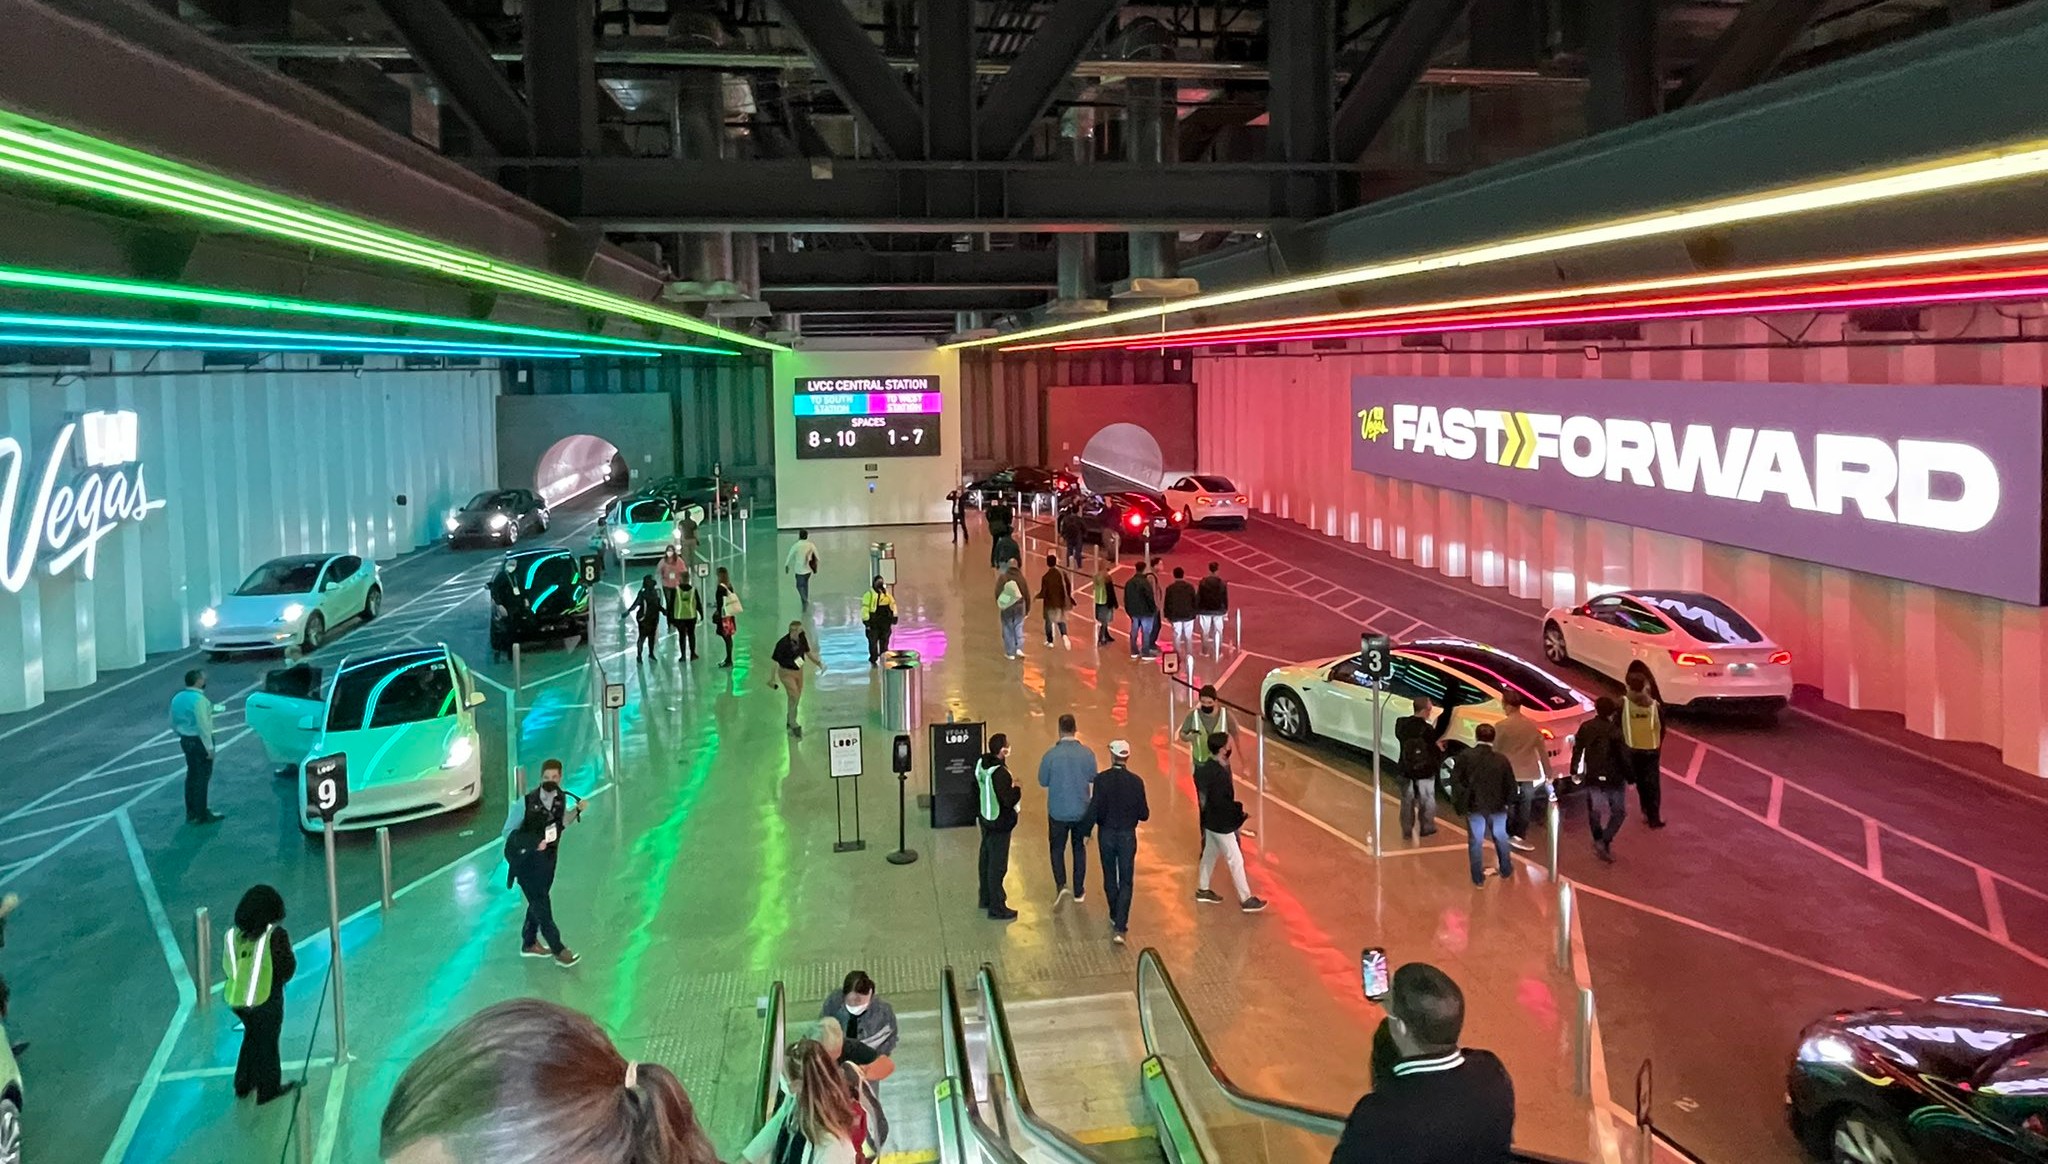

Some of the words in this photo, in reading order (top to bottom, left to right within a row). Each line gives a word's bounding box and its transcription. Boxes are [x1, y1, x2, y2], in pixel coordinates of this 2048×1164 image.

[808, 380, 834, 391] LVCC
[835, 380, 884, 391] CENTRAL
[885, 379, 928, 390] STATION
[823, 394, 854, 404] SOUTH
[898, 394, 922, 404] WEST
[814, 404, 850, 414] STATION
[886, 404, 923, 413] STATION
[851, 418, 886, 427] SPACES
[808, 431, 820, 447] 8
[836, 430, 856, 446] 10
[888, 429, 896, 445] 1
[913, 428, 923, 445] 7
[1393, 404, 1508, 465] FAST
[1520, 412, 2000, 533] FORWARD
[0, 422, 166, 592] Vegas
[585, 565, 595, 581] 8
[1369, 650, 1382, 672] 3
[833, 739, 858, 748] LOOP
[946, 735, 969, 744] LOOP
[318, 779, 337, 810] 9
